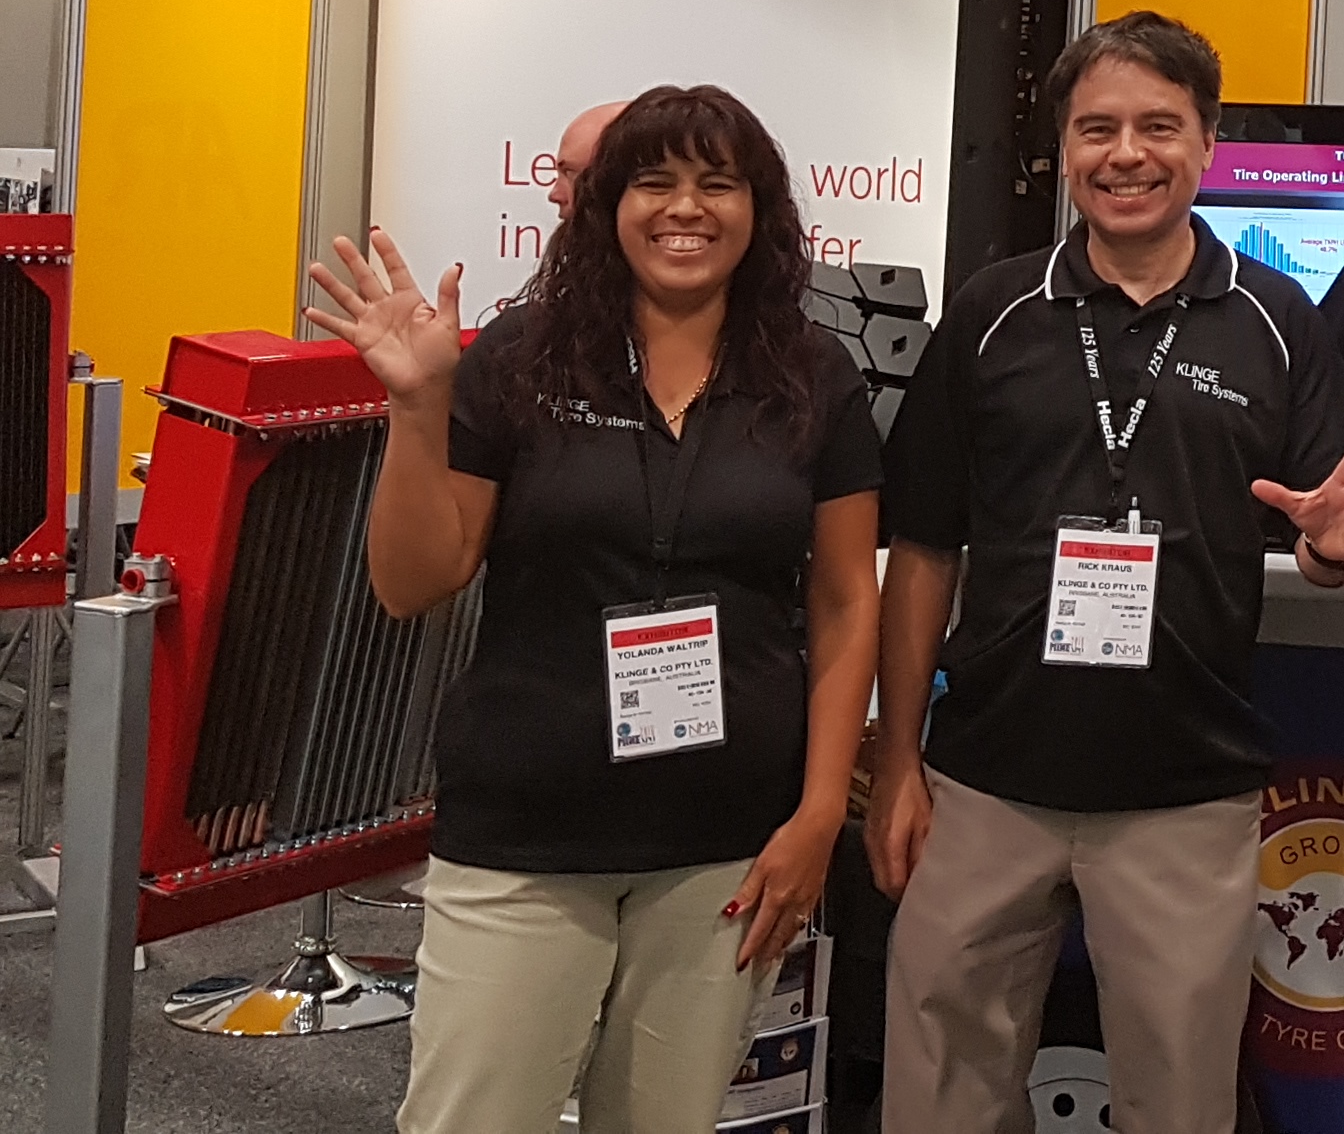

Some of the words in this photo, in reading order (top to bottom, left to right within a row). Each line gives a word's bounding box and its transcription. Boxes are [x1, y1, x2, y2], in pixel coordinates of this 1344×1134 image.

[810, 157, 923, 204] world
[1233, 169, 1259, 181] Tire
[1262, 169, 1328, 185] Operating
[500, 212, 541, 259] in
[1080, 326, 1096, 346] 125
[1084, 347, 1100, 379] Years
[1175, 361, 1221, 384] KLINGE
[1117, 398, 1147, 449] Hecla
[1148, 351, 1164, 379] 125
[1156, 323, 1178, 356] Years
[1211, 384, 1249, 407] Systems
[585, 412, 645, 431] Systems
[1096, 400, 1117, 451] Hecla
[1078, 562, 1099, 571] RICK
[1101, 564, 1133, 572] KRAUS
[1057, 579, 1088, 589] KLINGE
[1098, 582, 1110, 590] CO
[1113, 583, 1129, 591] PTY
[617, 647, 664, 660] YOLANDA
[666, 639, 708, 653] WALTRIP
[1115, 643, 1143, 656] NMA
[615, 668, 649, 680] KLINGE
[659, 665, 673, 673] CO
[675, 662, 691, 671] PTY
[688, 720, 718, 736] NMA
[1260, 1013, 1328, 1052] TYRE
